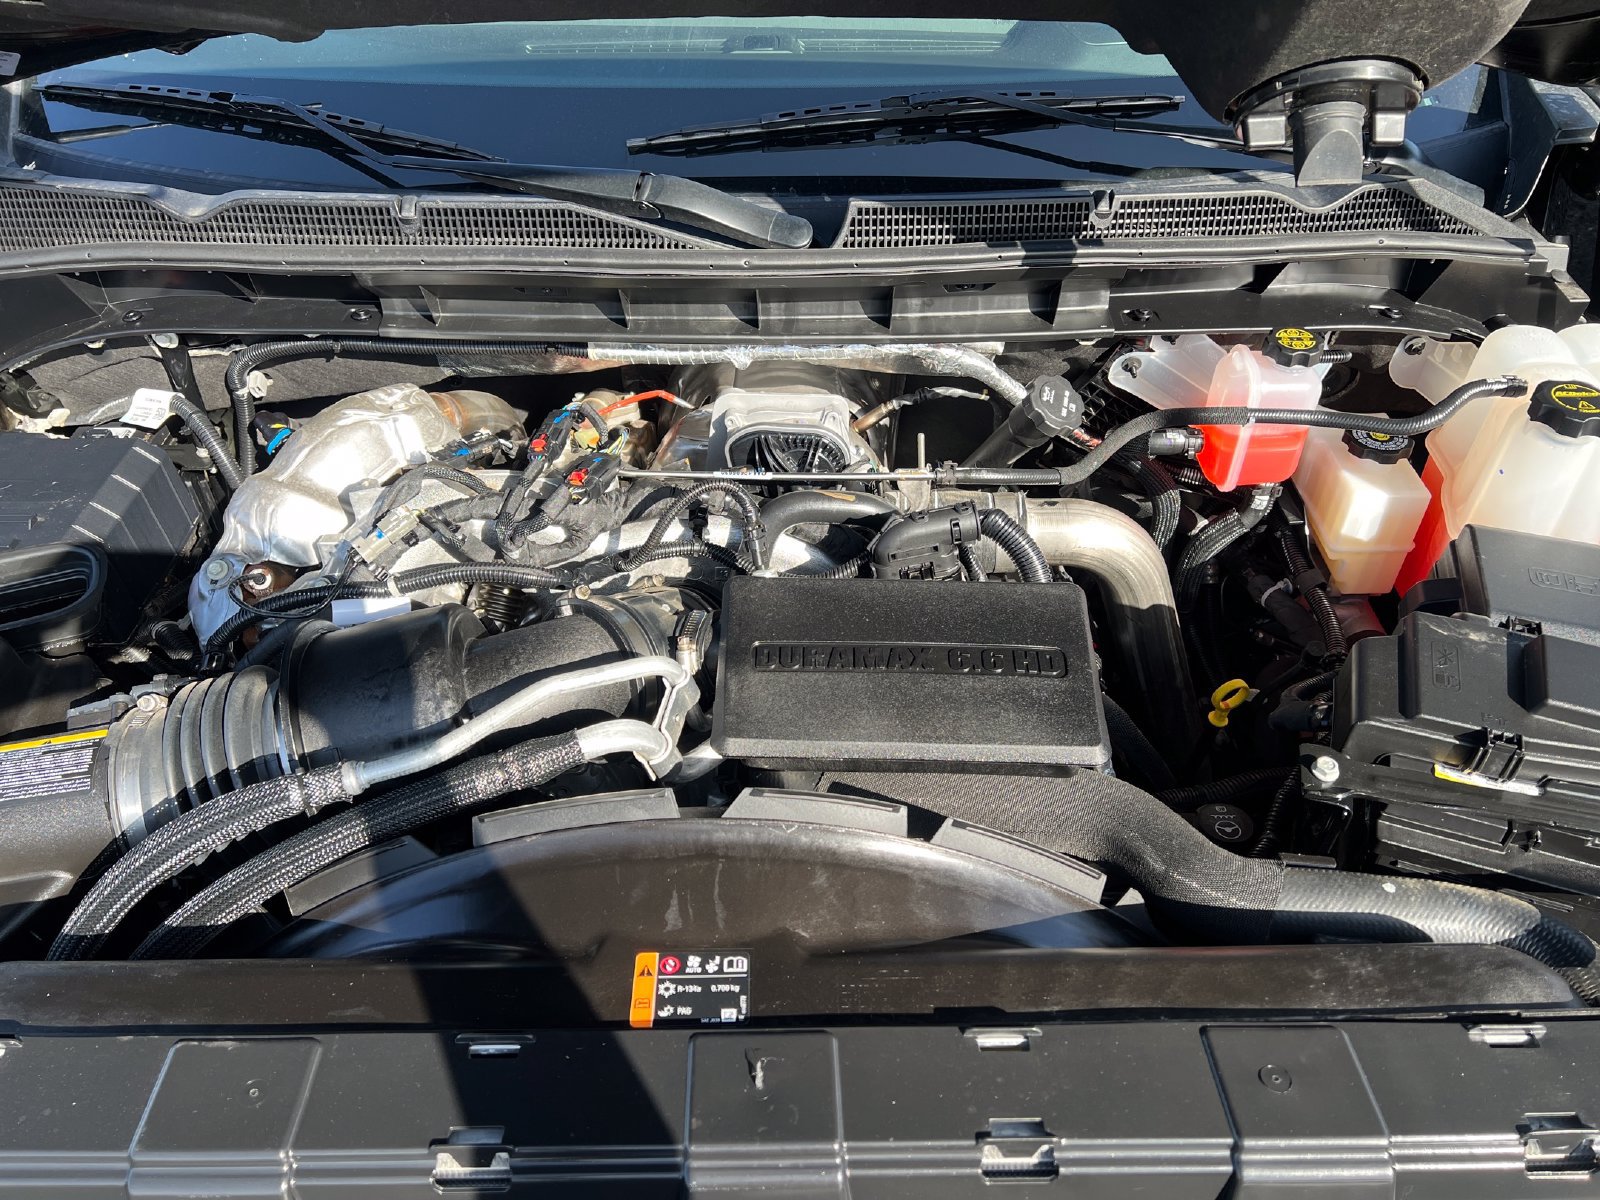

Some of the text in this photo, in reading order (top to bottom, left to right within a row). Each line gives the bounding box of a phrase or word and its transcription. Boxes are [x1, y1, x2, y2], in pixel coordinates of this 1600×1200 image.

[753, 646, 1063, 676] DURAMAX 6.6 HD
[677, 984, 740, 993] R-134a 0.700 kg
[677, 1006, 692, 1016] PAG
